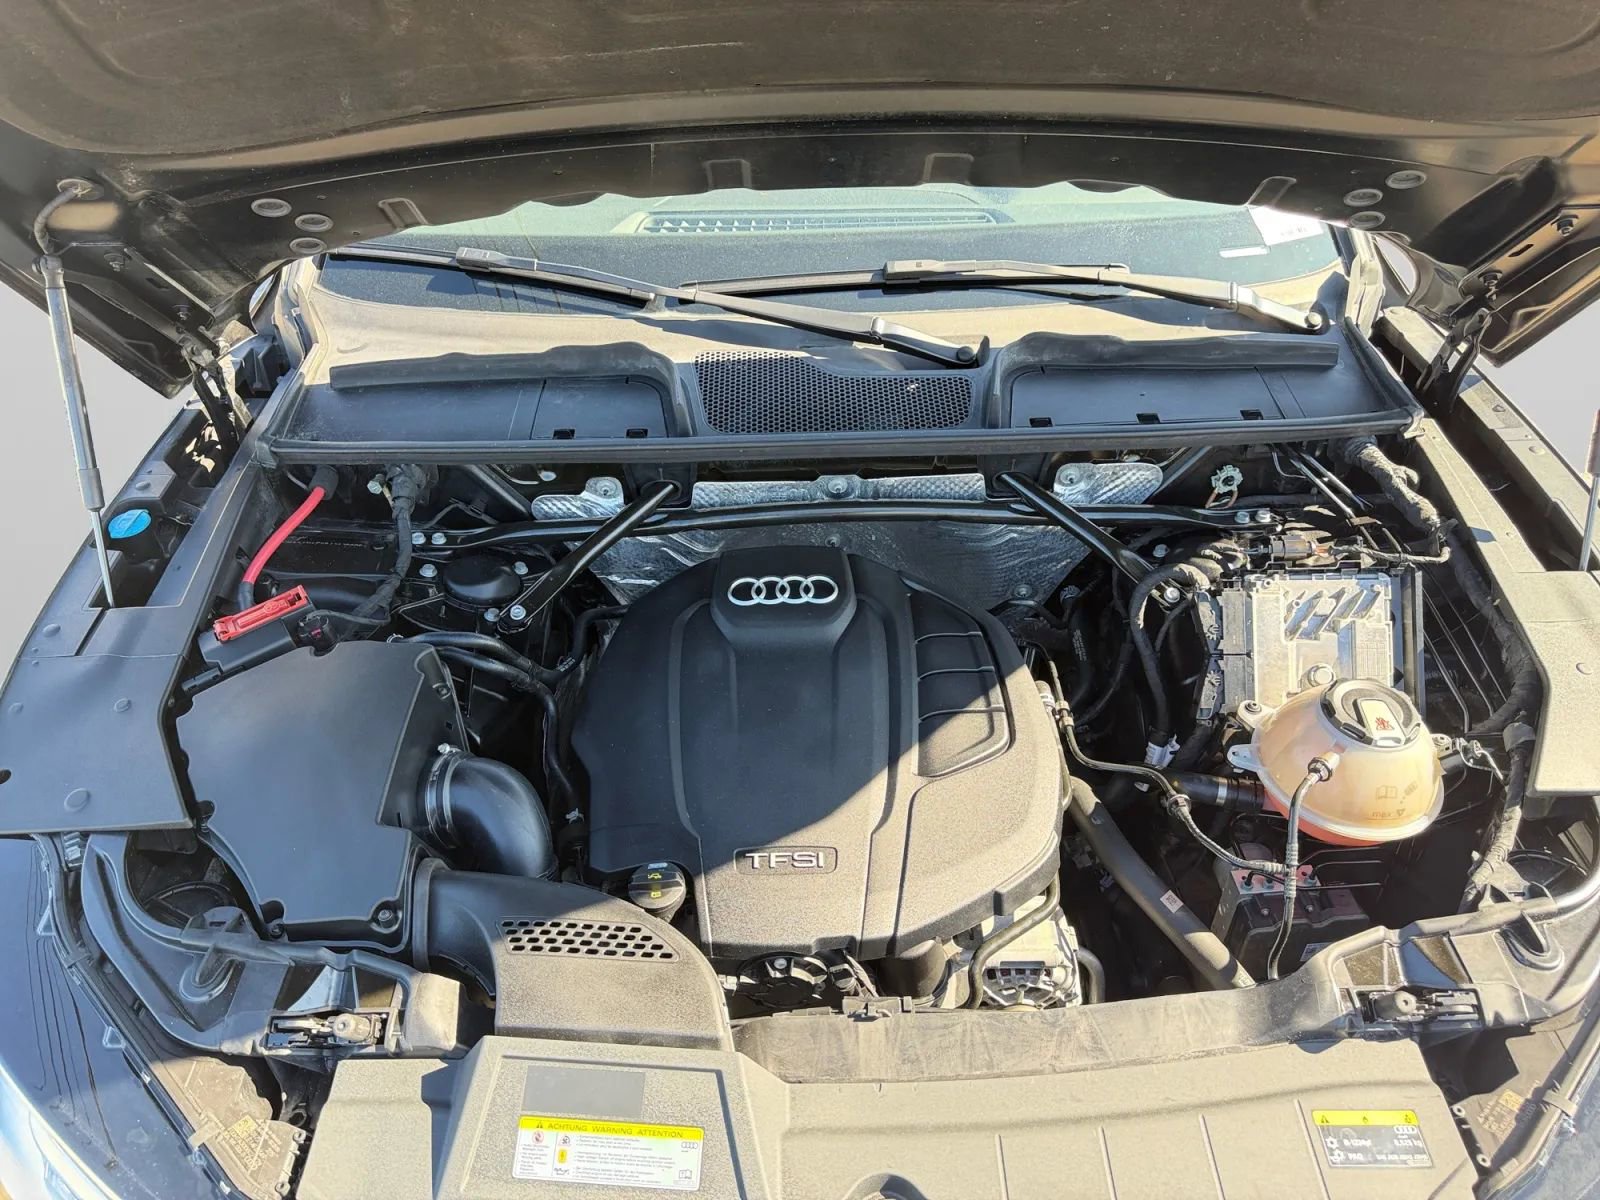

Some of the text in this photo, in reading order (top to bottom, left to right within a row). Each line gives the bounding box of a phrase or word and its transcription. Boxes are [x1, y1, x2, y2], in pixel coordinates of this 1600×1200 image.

[744, 852, 825, 869] TFSI
[548, 1122, 683, 1138] ACHTUNG WARNING ATTENTION
